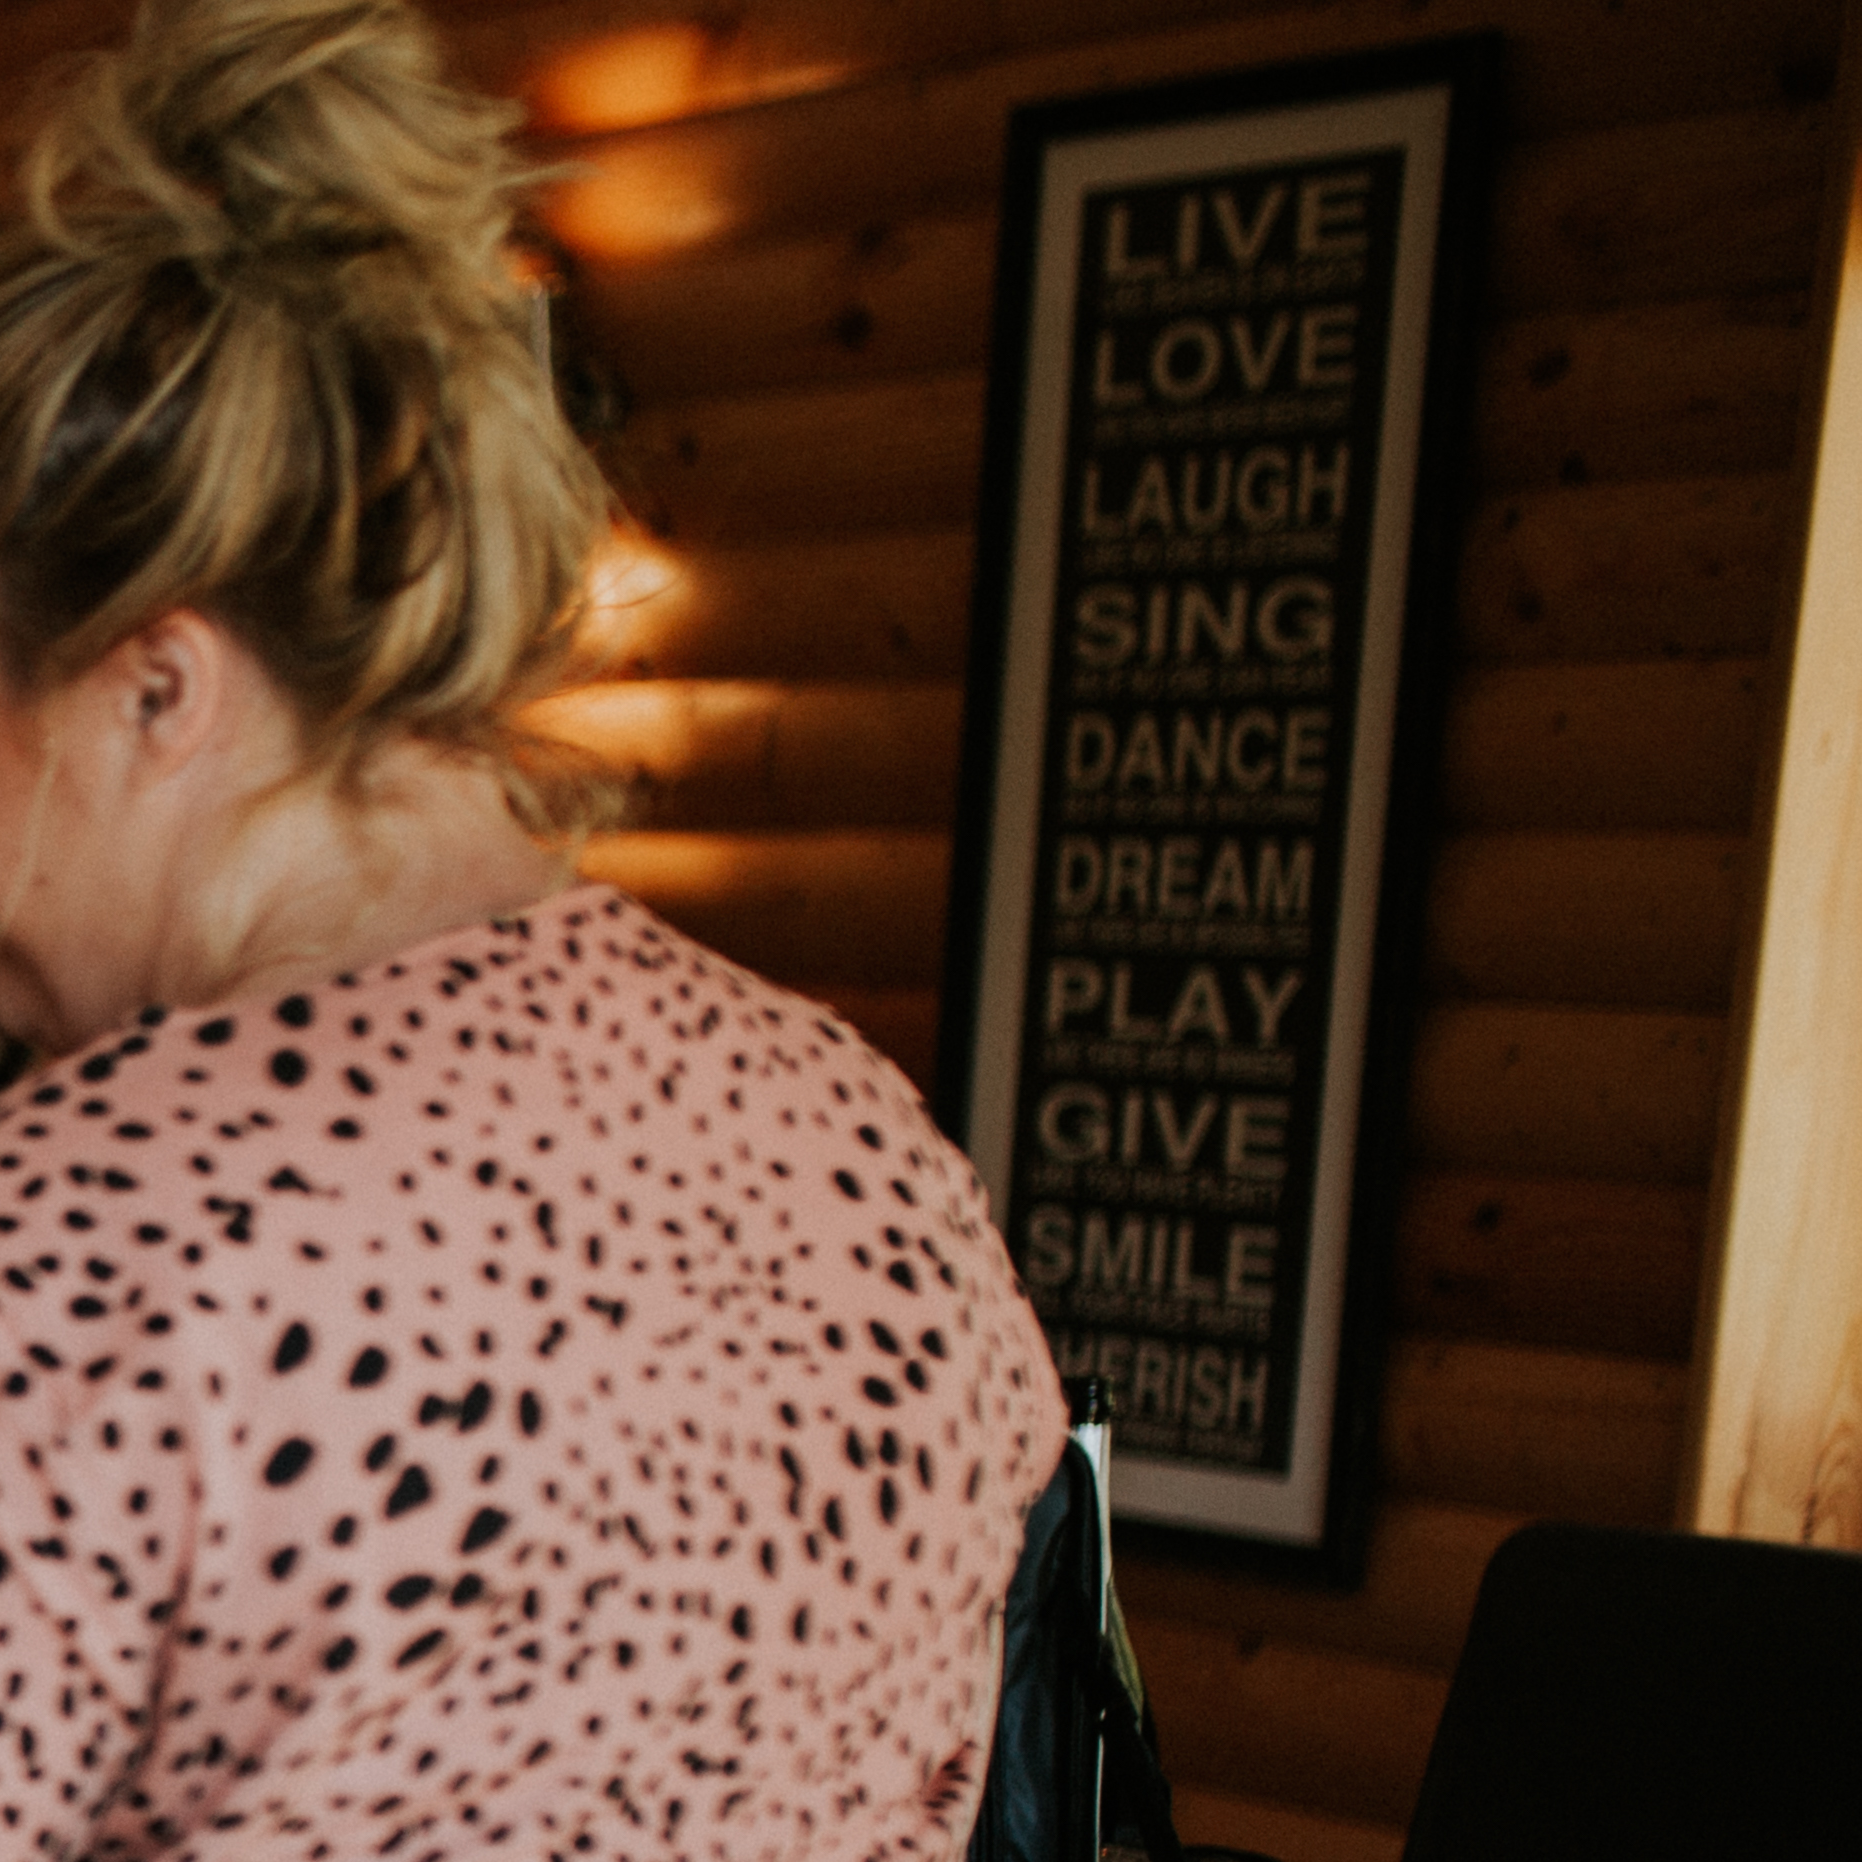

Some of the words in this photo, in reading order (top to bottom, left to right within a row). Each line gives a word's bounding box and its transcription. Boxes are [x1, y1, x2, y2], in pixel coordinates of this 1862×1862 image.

[1106, 173, 1369, 277] LIVE
[1093, 304, 1361, 404] LOVE
[1081, 441, 1352, 533] LAUGH
[1076, 574, 1336, 668] SING
[1064, 708, 1332, 794] DANCE
[1056, 835, 1315, 917] DREAM
[1045, 956, 1305, 1047] PLAY
[1037, 1083, 1291, 1178] GIVE
[1025, 1202, 1280, 1307] SMILE
[1050, 1325, 1270, 1432] HERISH
